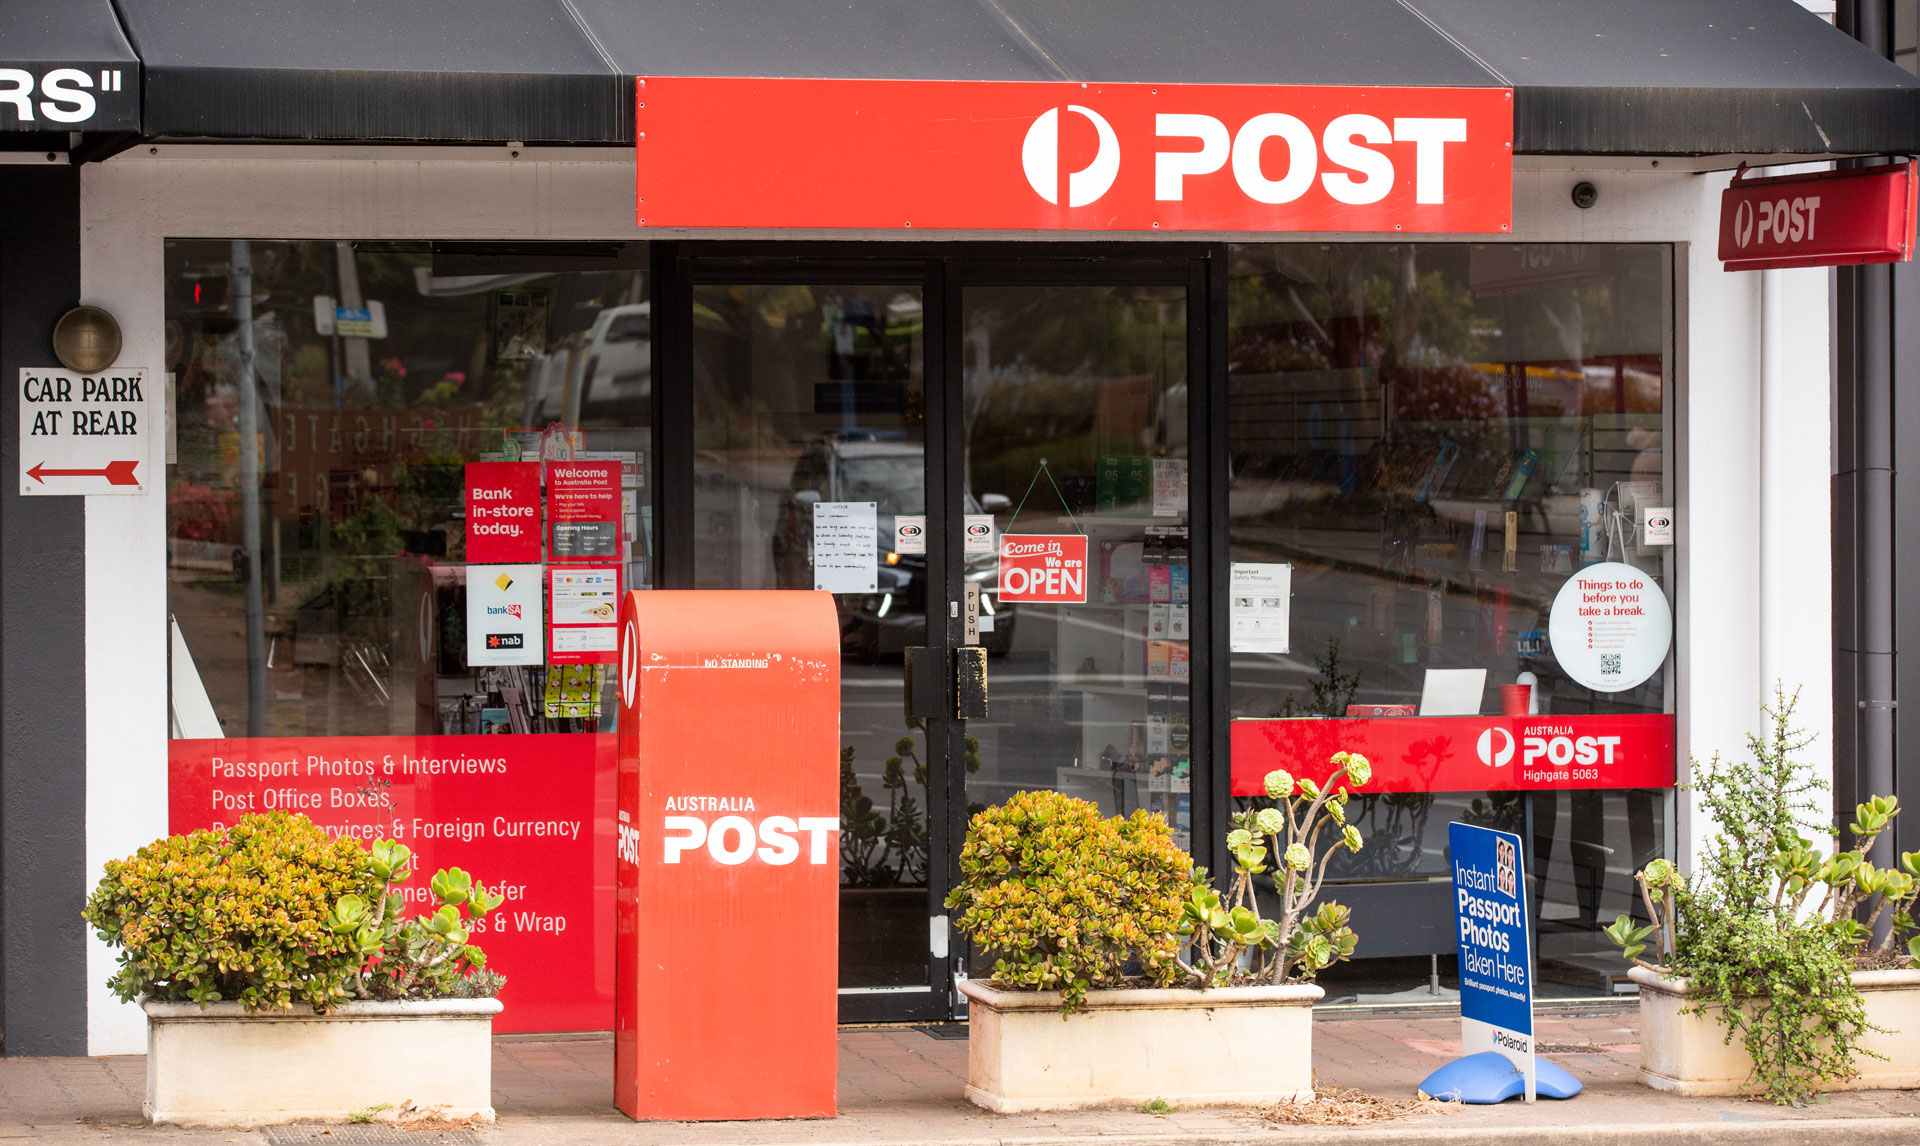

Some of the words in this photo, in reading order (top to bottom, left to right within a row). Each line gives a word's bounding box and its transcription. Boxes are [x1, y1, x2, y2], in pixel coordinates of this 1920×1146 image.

[1155, 112, 1467, 205] POST
[1757, 196, 1821, 245] POST
[23, 377, 72, 402] CAR
[81, 377, 144, 402] PARK
[31, 410, 63, 436] AT
[72, 410, 138, 437] REAR
[554, 468, 608, 478] Welcome
[472, 487, 513, 500] Bank
[598, 492, 613, 500] help
[472, 504, 534, 517] in-store
[472, 521, 524, 537] today.
[1005, 542, 1045, 555] Come
[1047, 540, 1062, 553] in
[1045, 557, 1061, 567] We
[1064, 559, 1082, 567] are
[1004, 567, 1083, 595] OPEN
[1577, 579, 1613, 592] Things
[1615, 580, 1626, 590] to
[1629, 579, 1643, 590] do
[1579, 606, 1601, 616] take
[1604, 608, 1610, 616] a
[1613, 605, 1645, 616] break.
[1583, 592, 1617, 604] before
[1619, 594, 1639, 606] you
[968, 591, 976, 636] PUSH
[501, 636, 521, 646] nab
[704, 658, 718, 668] NO
[720, 658, 769, 669] STANDING
[1524, 725, 1574, 735] AUSTRALIA
[1523, 735, 1621, 766] POST
[212, 757, 299, 781] Passport
[307, 755, 375, 776] Photos
[383, 754, 395, 775] &
[403, 754, 507, 775] Interviews
[1523, 769, 1570, 783] Highgate
[1572, 769, 1598, 780] 5063
[212, 789, 255, 810] Post
[263, 788, 322, 809] Office
[330, 787, 390, 808] Boxes
[664, 796, 756, 812] AUSTRALIA
[315, 819, 384, 840] rvices
[393, 818, 405, 839] &
[413, 817, 484, 842] Foreign
[493, 815, 581, 840] Currency
[618, 823, 640, 865] POST
[663, 815, 840, 866] POST
[1455, 859, 1496, 893] Instant
[386, 883, 437, 906] oney
[1458, 887, 1522, 928] Passport
[494, 912, 507, 933] &
[514, 911, 566, 936] Wrap
[1460, 915, 1510, 953] Photos
[1461, 944, 1496, 978] Taken
[1496, 953, 1525, 986] Here
[1464, 977, 1479, 989] Brilliant
[1479, 982, 1496, 993] passport
[1497, 1031, 1528, 1053] Polaroid
